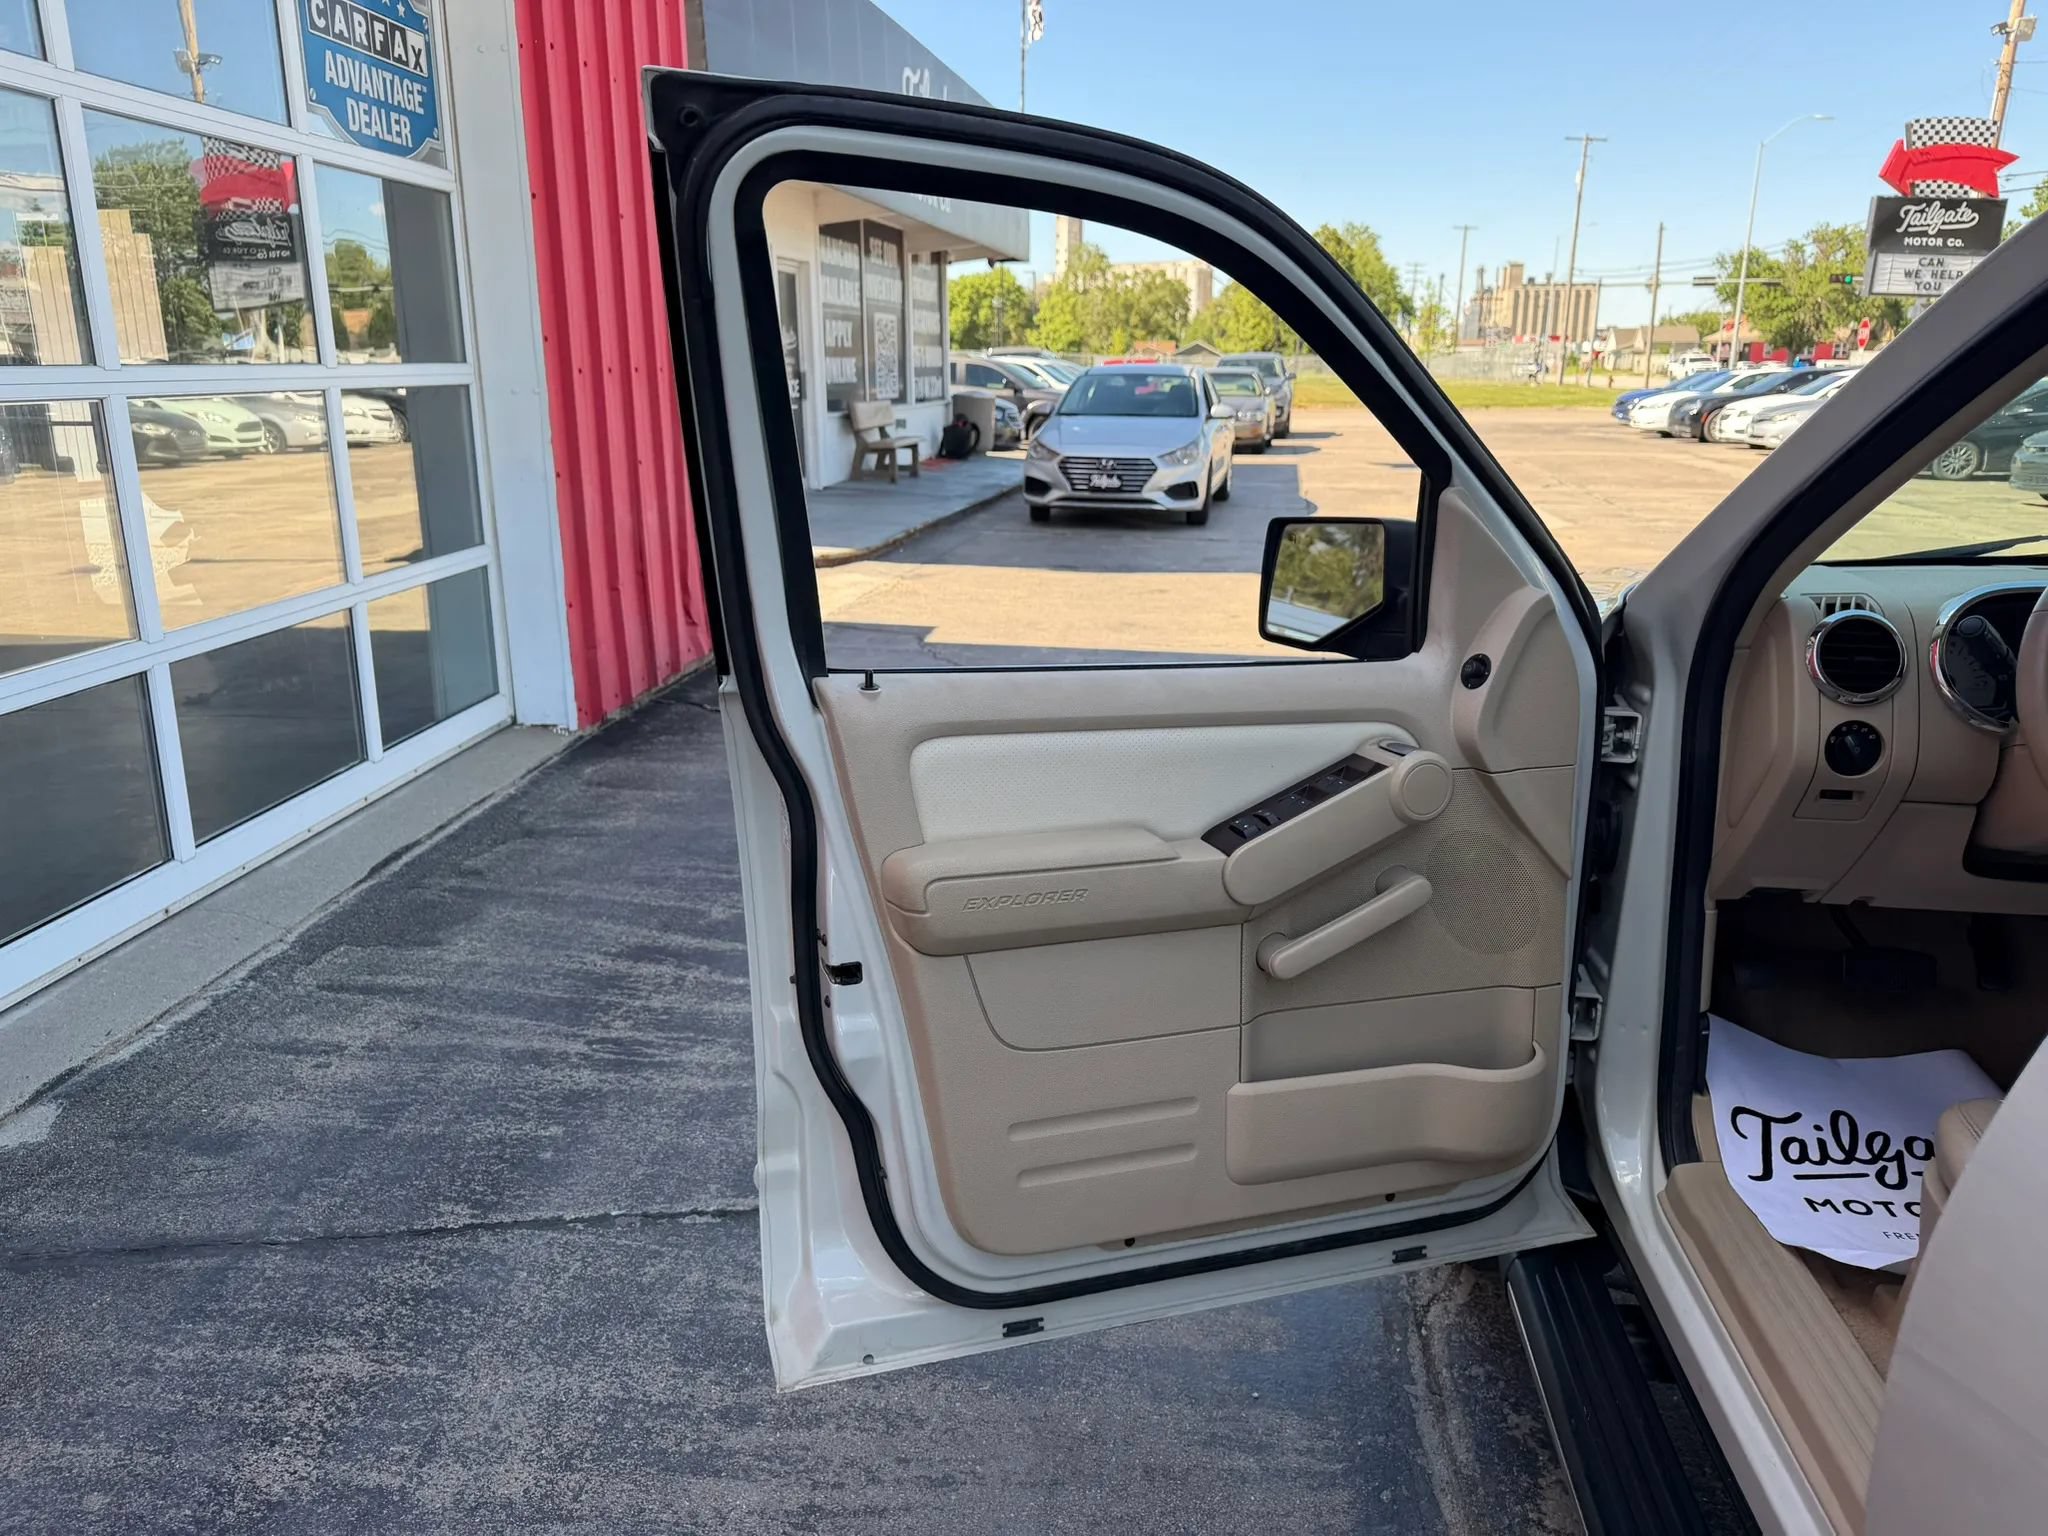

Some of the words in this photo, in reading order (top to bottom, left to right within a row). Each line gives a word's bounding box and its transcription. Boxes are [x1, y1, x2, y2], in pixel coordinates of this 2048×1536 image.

[311, 0, 424, 74] CARFAX
[324, 49, 425, 116] ADVANTAGE
[346, 97, 413, 148] DEALER
[1895, 200, 1979, 235] Tailgate
[1903, 236, 1943, 247] MOTOR
[1904, 268, 1922, 279] WE
[1930, 269, 1964, 280] HELP
[1918, 257, 1944, 267] CAN
[1915, 281, 1942, 291] YOU
[962, 888, 1089, 913] EXPLORER
